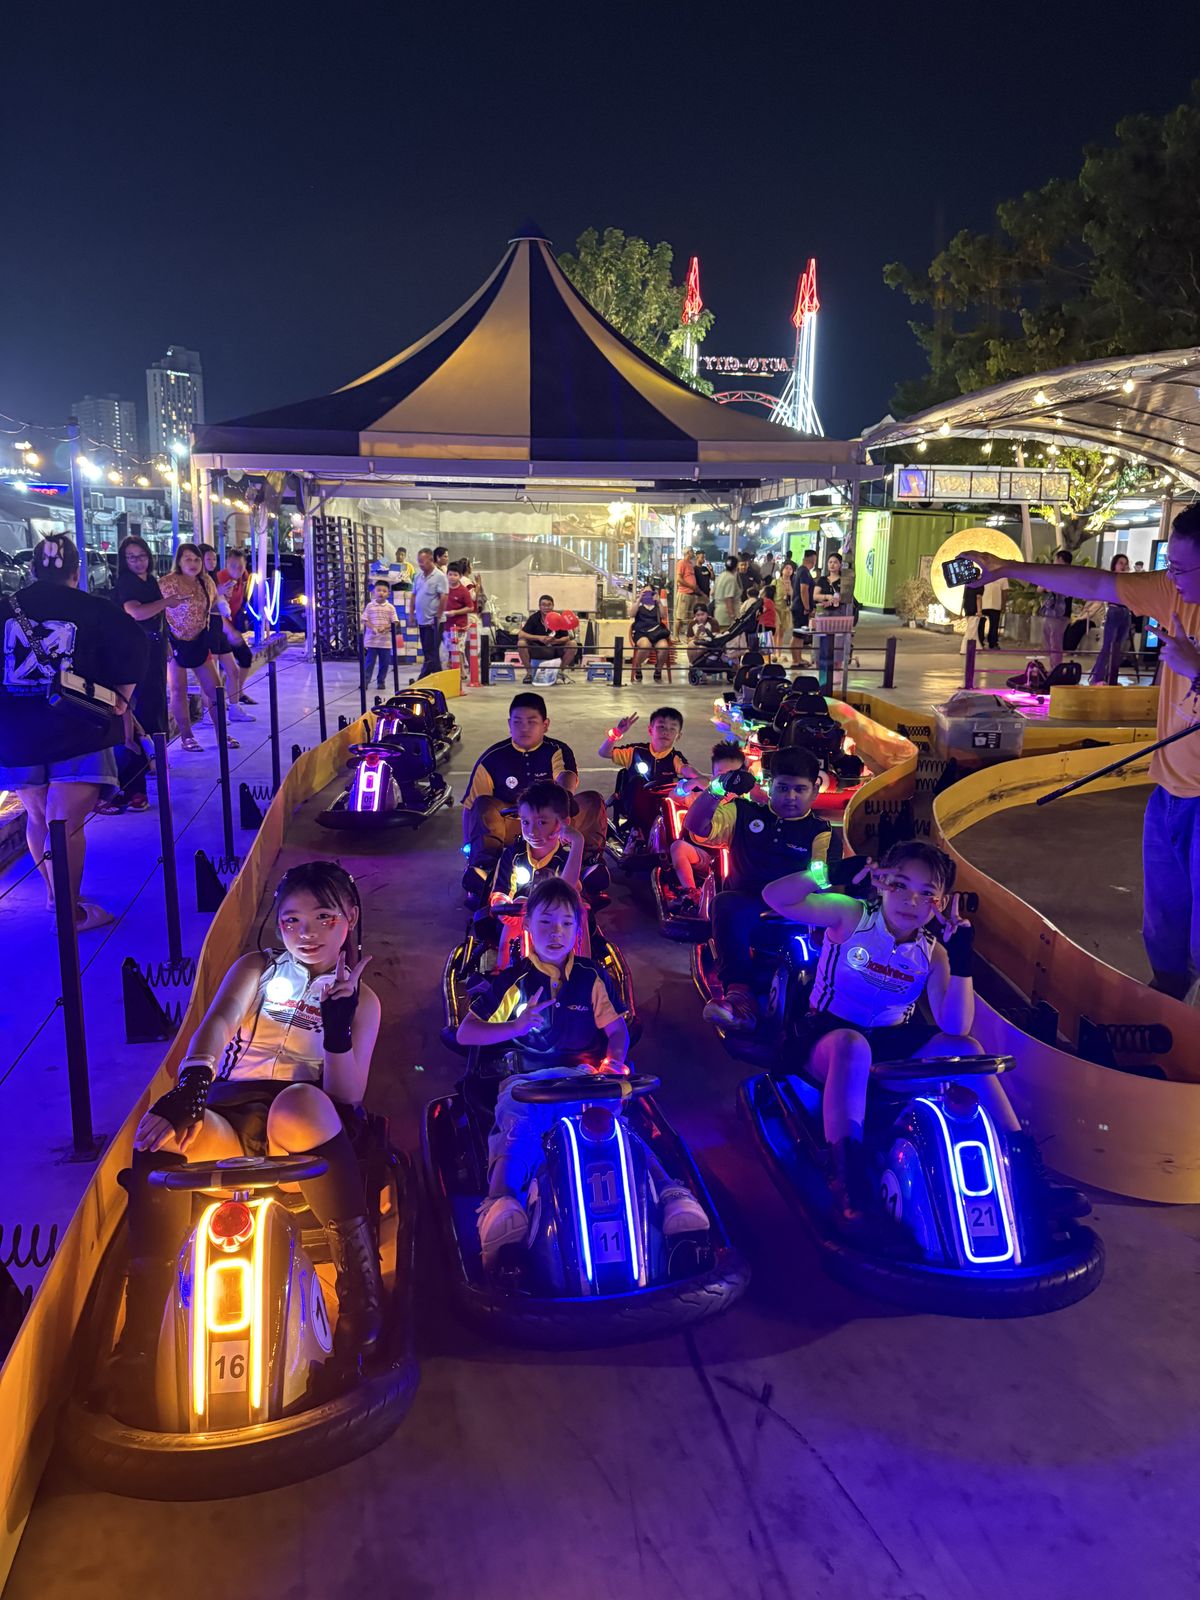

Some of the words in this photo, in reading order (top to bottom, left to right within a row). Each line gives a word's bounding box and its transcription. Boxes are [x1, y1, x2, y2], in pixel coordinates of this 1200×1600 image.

[587, 1169, 618, 1210] 11
[970, 1206, 995, 1227] 21
[600, 1231, 620, 1252] 11
[214, 1354, 245, 1380] 16
